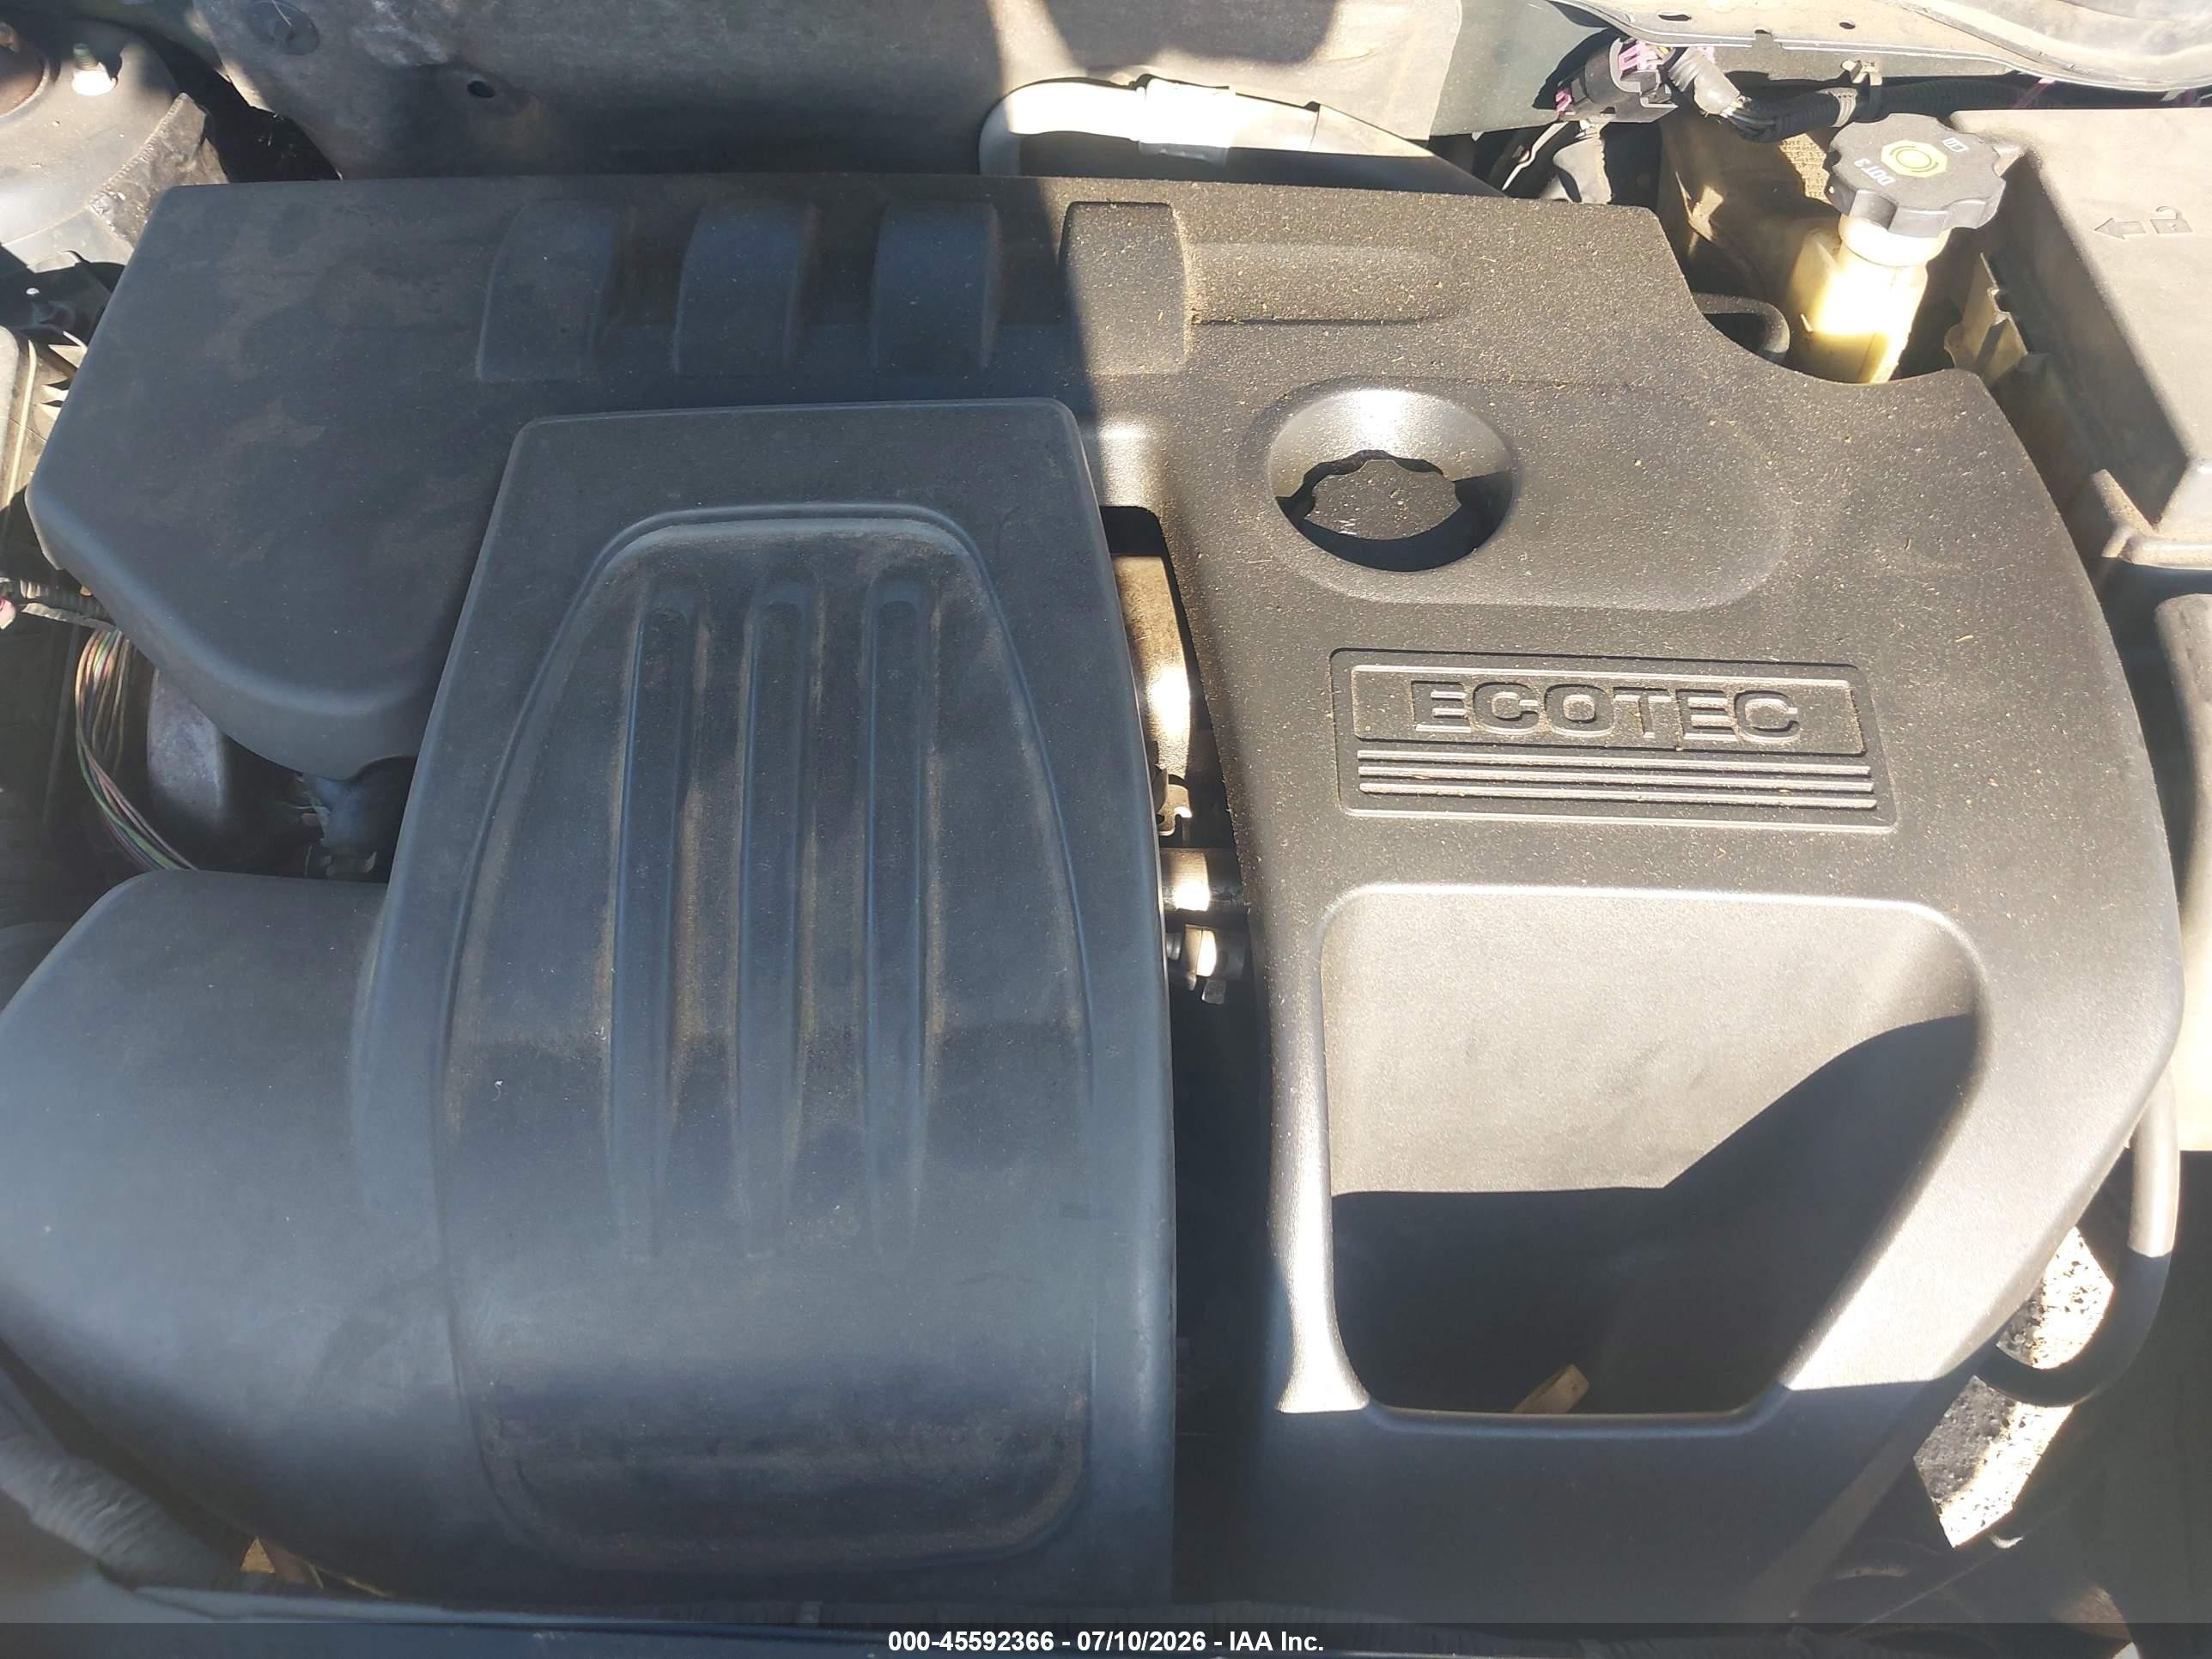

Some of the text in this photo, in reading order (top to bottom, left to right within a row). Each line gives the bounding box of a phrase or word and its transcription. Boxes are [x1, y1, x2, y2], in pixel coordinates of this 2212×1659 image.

[1854, 158, 1897, 186] DOT 3
[1411, 680, 1801, 744] ECOTEC
